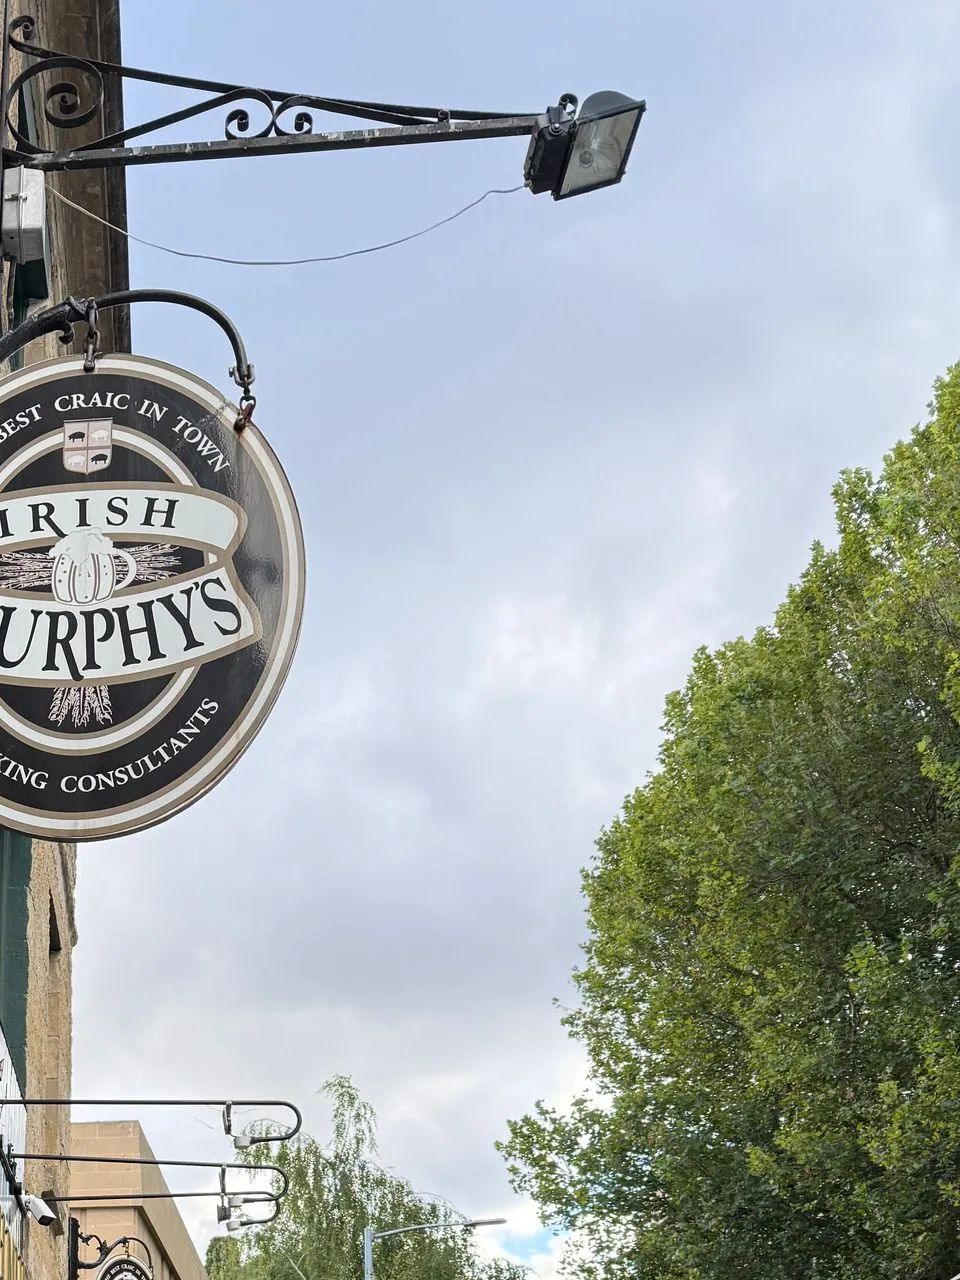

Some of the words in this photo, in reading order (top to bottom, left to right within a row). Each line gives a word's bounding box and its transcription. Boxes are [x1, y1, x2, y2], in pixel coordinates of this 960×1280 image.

[53, 391, 131, 413] CRAIC
[138, 398, 169, 423] IN
[172, 415, 231, 475] TOWN
[61, 697, 221, 794] CONSULTANTS
